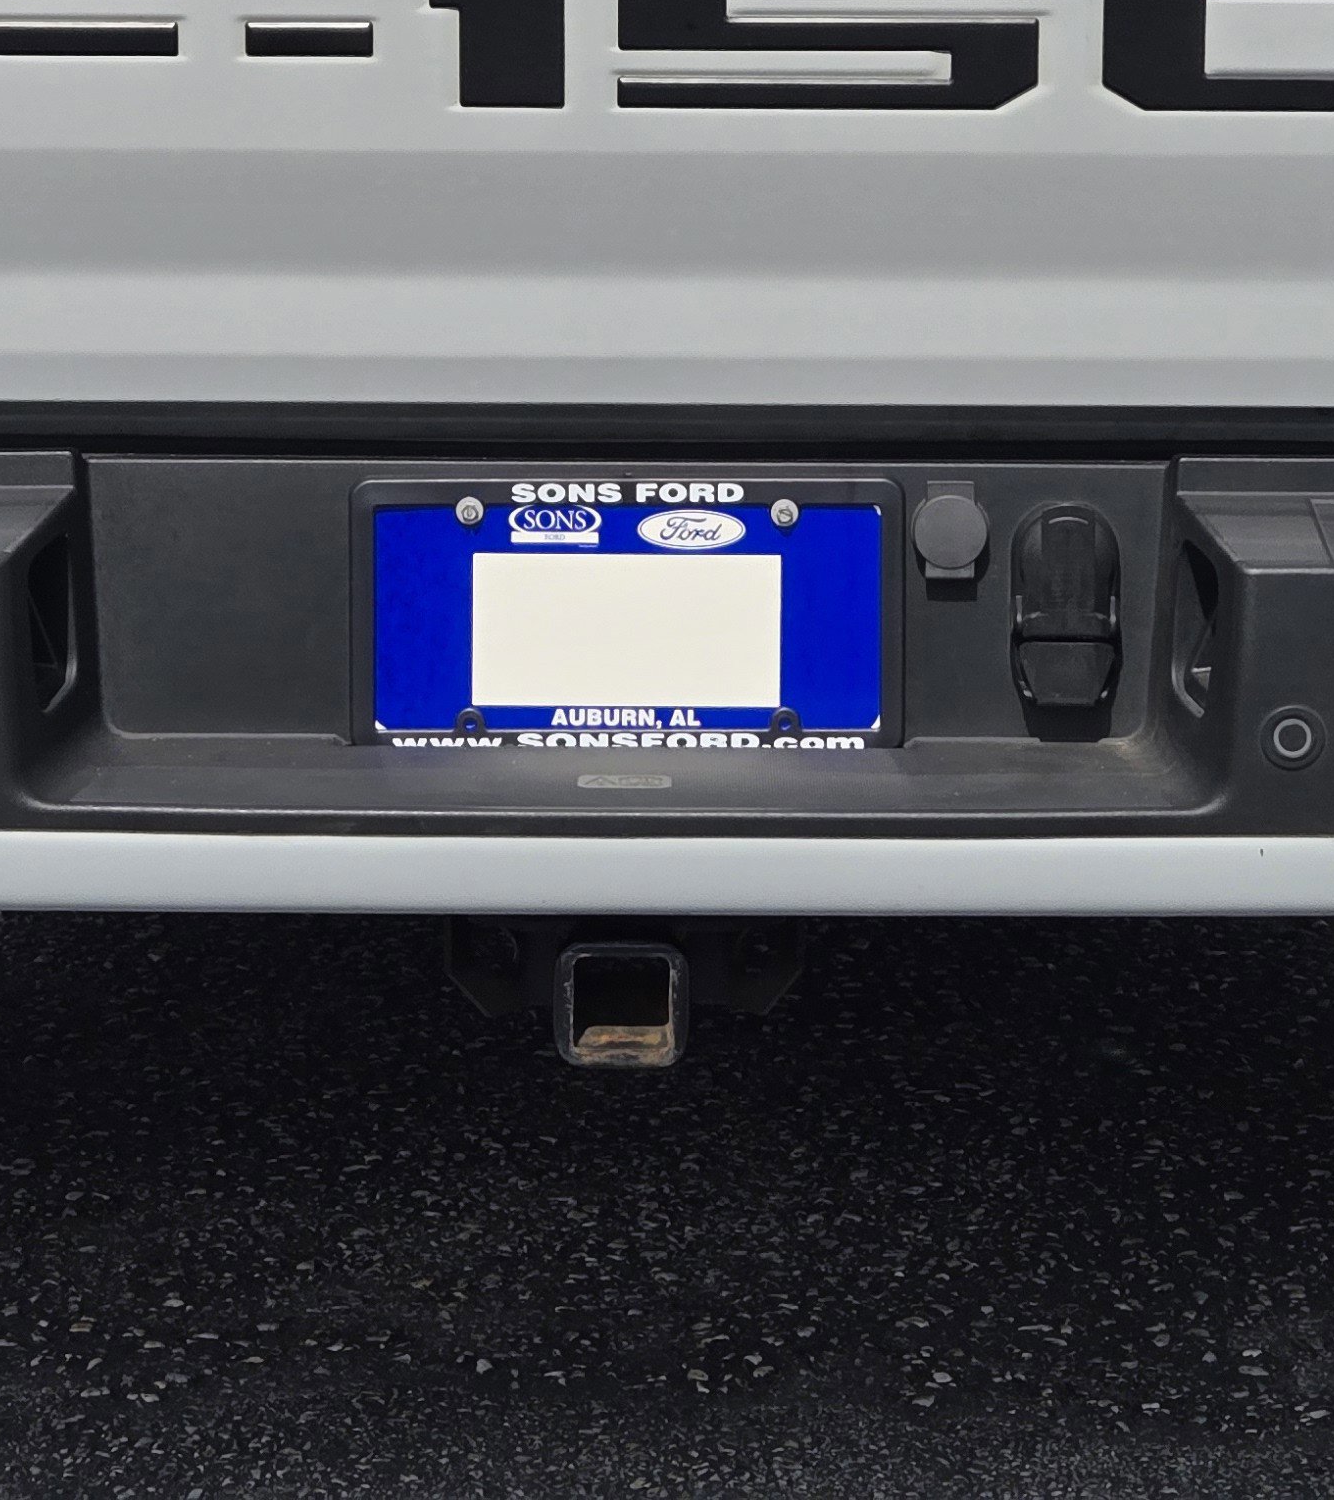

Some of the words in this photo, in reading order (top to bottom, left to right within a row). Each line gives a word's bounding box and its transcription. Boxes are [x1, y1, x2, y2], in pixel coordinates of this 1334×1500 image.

[511, 483, 622, 503] SONS
[636, 483, 745, 503] FORD
[523, 509, 588, 530] SONS
[659, 515, 723, 541] Ford
[551, 708, 663, 729] AUBURN,
[669, 709, 701, 727] AL
[392, 732, 866, 750] wwwSONSFORD.com
